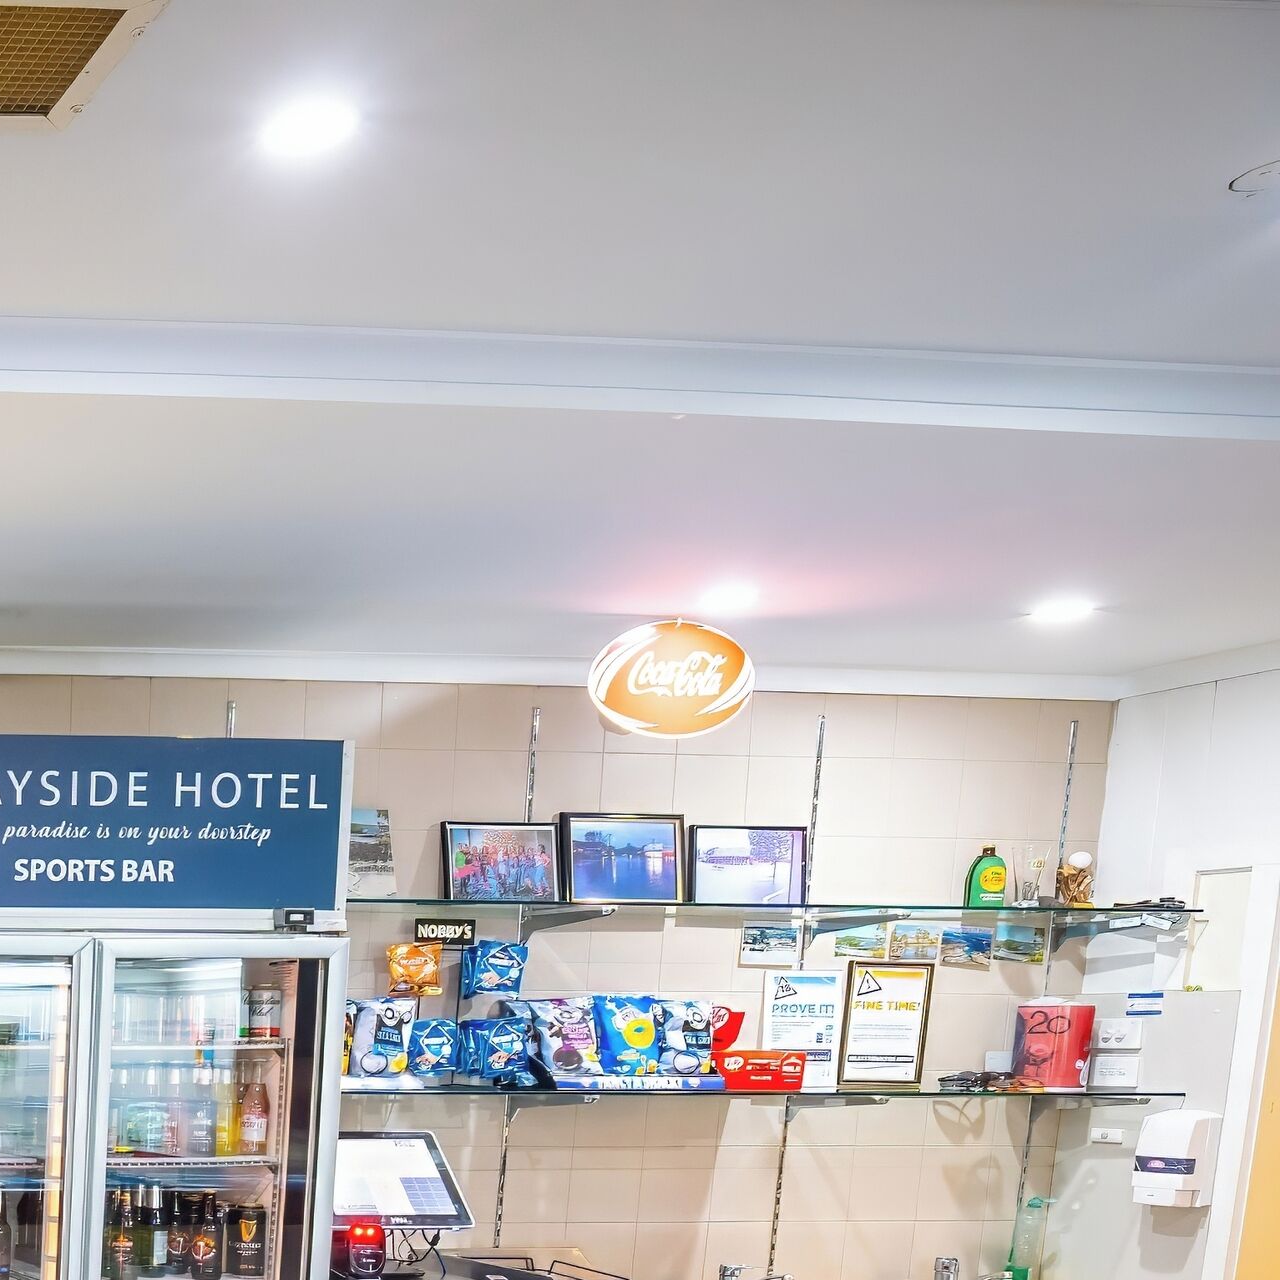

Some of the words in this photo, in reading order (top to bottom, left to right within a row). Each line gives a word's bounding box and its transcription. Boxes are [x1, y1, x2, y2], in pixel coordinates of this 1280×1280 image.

[175, 771, 328, 810] HOTEL
[1, 819, 91, 844] paradise
[96, 823, 111, 839] is
[118, 826, 142, 839] on
[146, 824, 191, 847] your
[198, 820, 271, 846] doorstep
[14, 858, 117, 883] SPORTS
[121, 858, 175, 883] BAR
[771, 1003, 816, 1014] PROVE
[853, 1001, 884, 1011] FINE
[1027, 1010, 1071, 1035] 20
